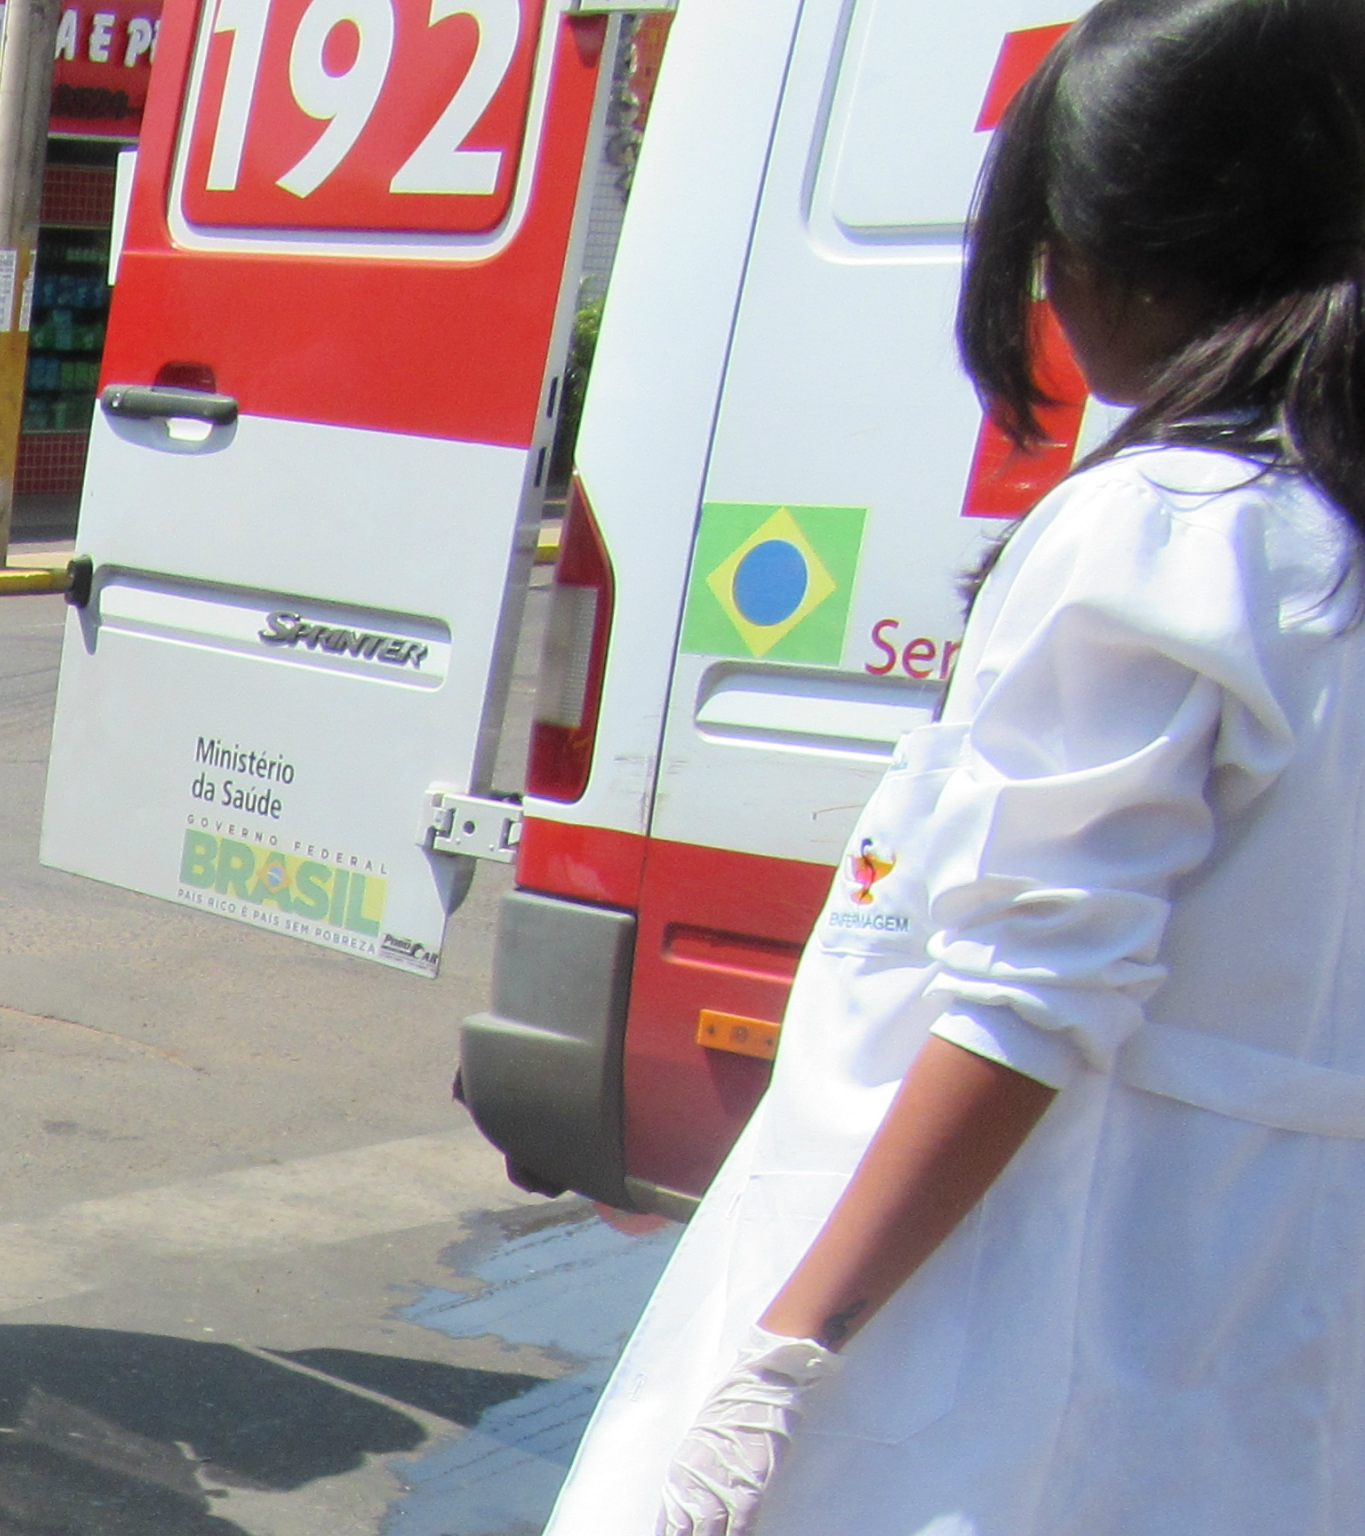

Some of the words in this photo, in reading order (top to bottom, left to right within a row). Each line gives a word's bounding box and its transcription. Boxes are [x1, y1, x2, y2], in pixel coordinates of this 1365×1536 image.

[88, 12, 116, 63] E
[205, 0, 520, 198] 192
[258, 611, 429, 670] SPRINTER
[195, 736, 295, 785] Ministério
[191, 772, 216, 802] da
[221, 780, 283, 819] Saúde
[187, 814, 278, 846] GOVERNO
[294, 841, 389, 875] FEDERAL
[179, 828, 381, 938] BRASIL
[207, 897, 237, 914] RICO
[284, 919, 310, 936] SEM
[314, 928, 377, 955] POBREZA
[829, 911, 910, 932] ENFERMAGEM
